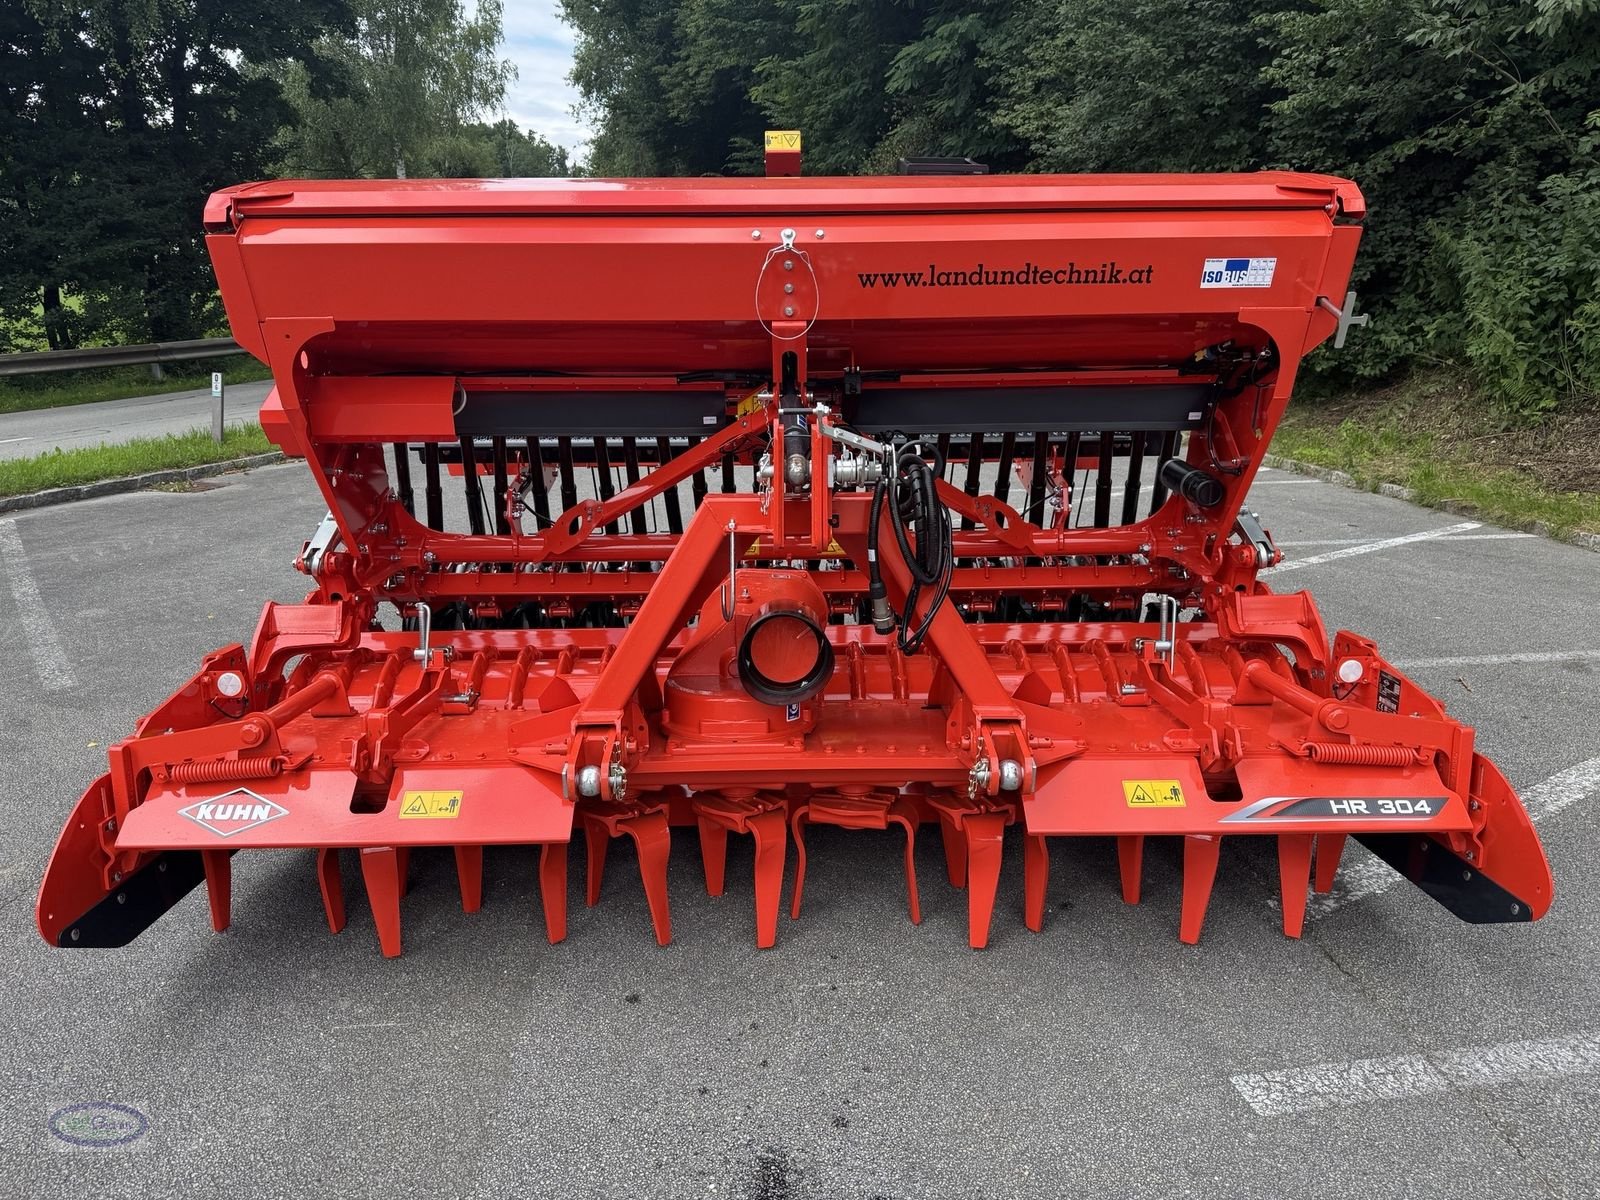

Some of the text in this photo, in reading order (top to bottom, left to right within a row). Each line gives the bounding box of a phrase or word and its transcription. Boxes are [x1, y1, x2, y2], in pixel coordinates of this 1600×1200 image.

[857, 262, 1153, 288] www.landundtechnik.at
[196, 804, 271, 820] KUHN
[1329, 799, 1432, 814] HR 304
